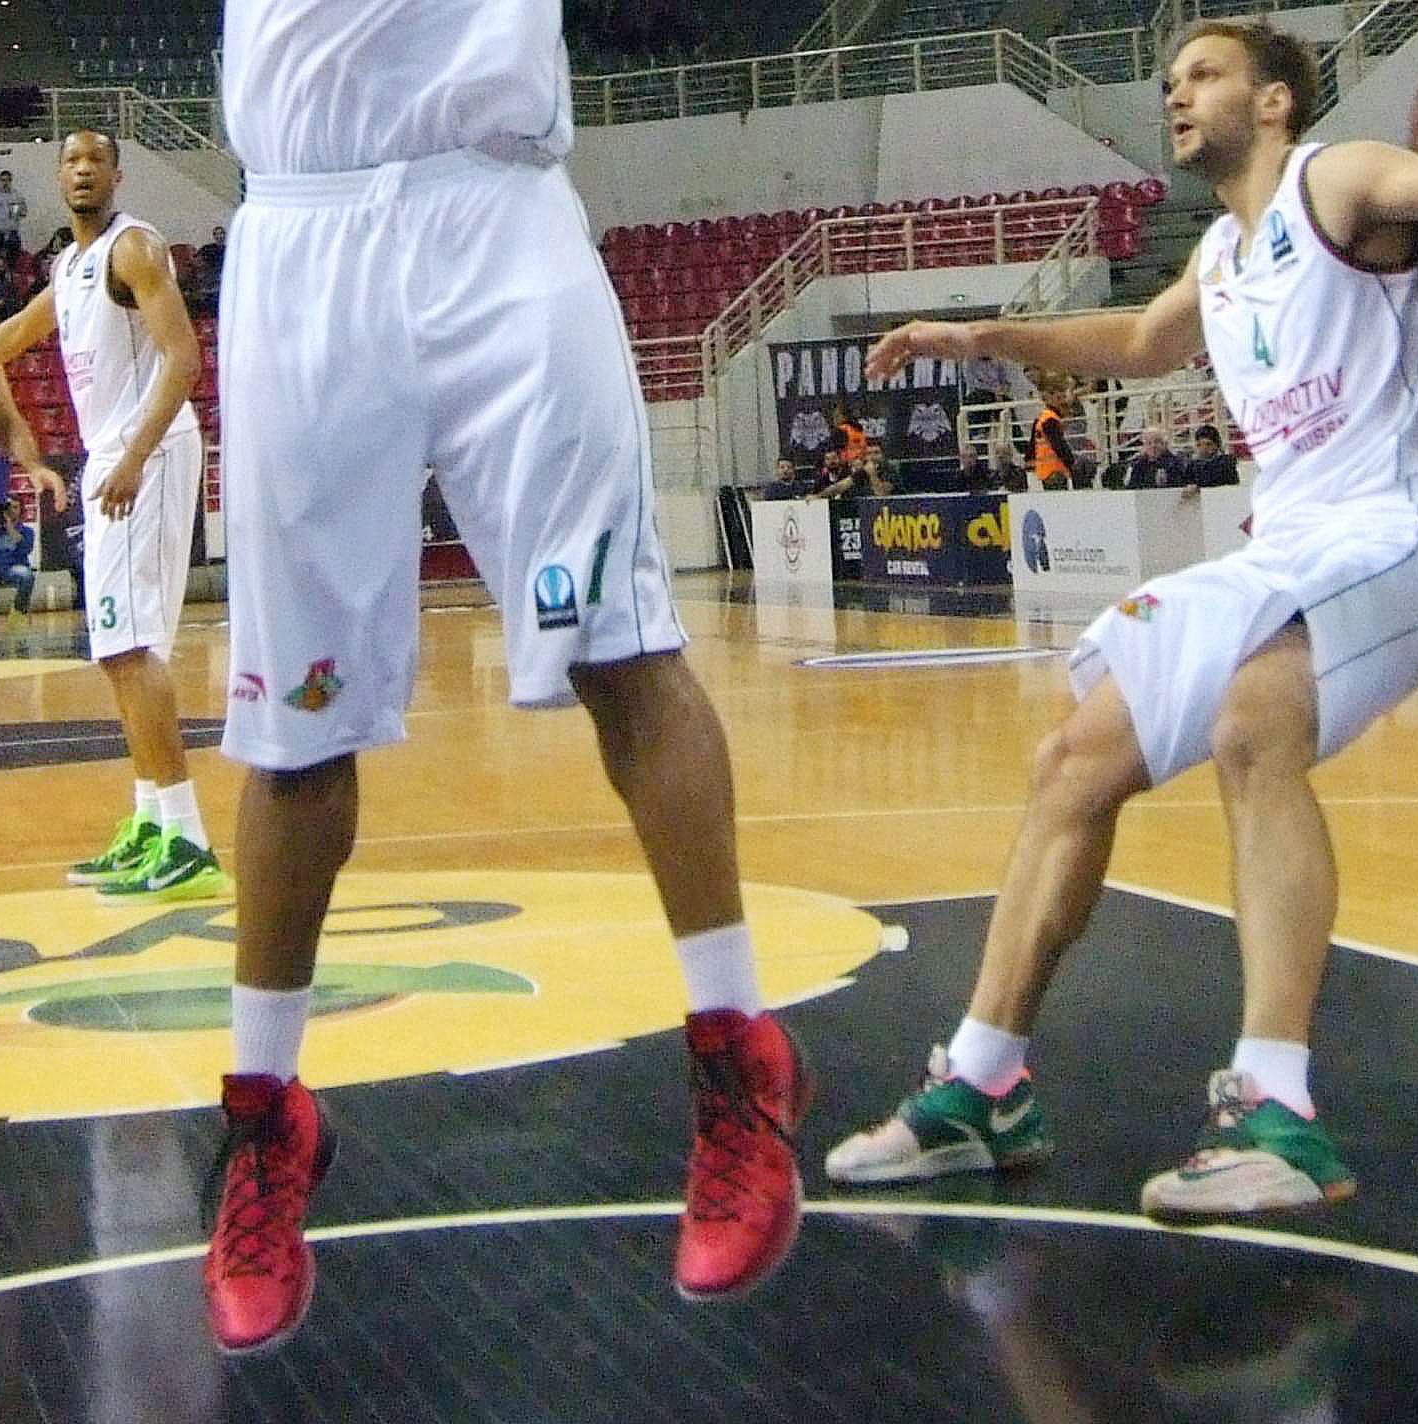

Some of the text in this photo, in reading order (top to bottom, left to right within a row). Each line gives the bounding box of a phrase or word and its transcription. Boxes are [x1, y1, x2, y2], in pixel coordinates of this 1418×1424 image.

[1253, 312, 1276, 368] 4
[776, 345, 958, 400] PANOMA
[99, 595, 119, 630] 3
